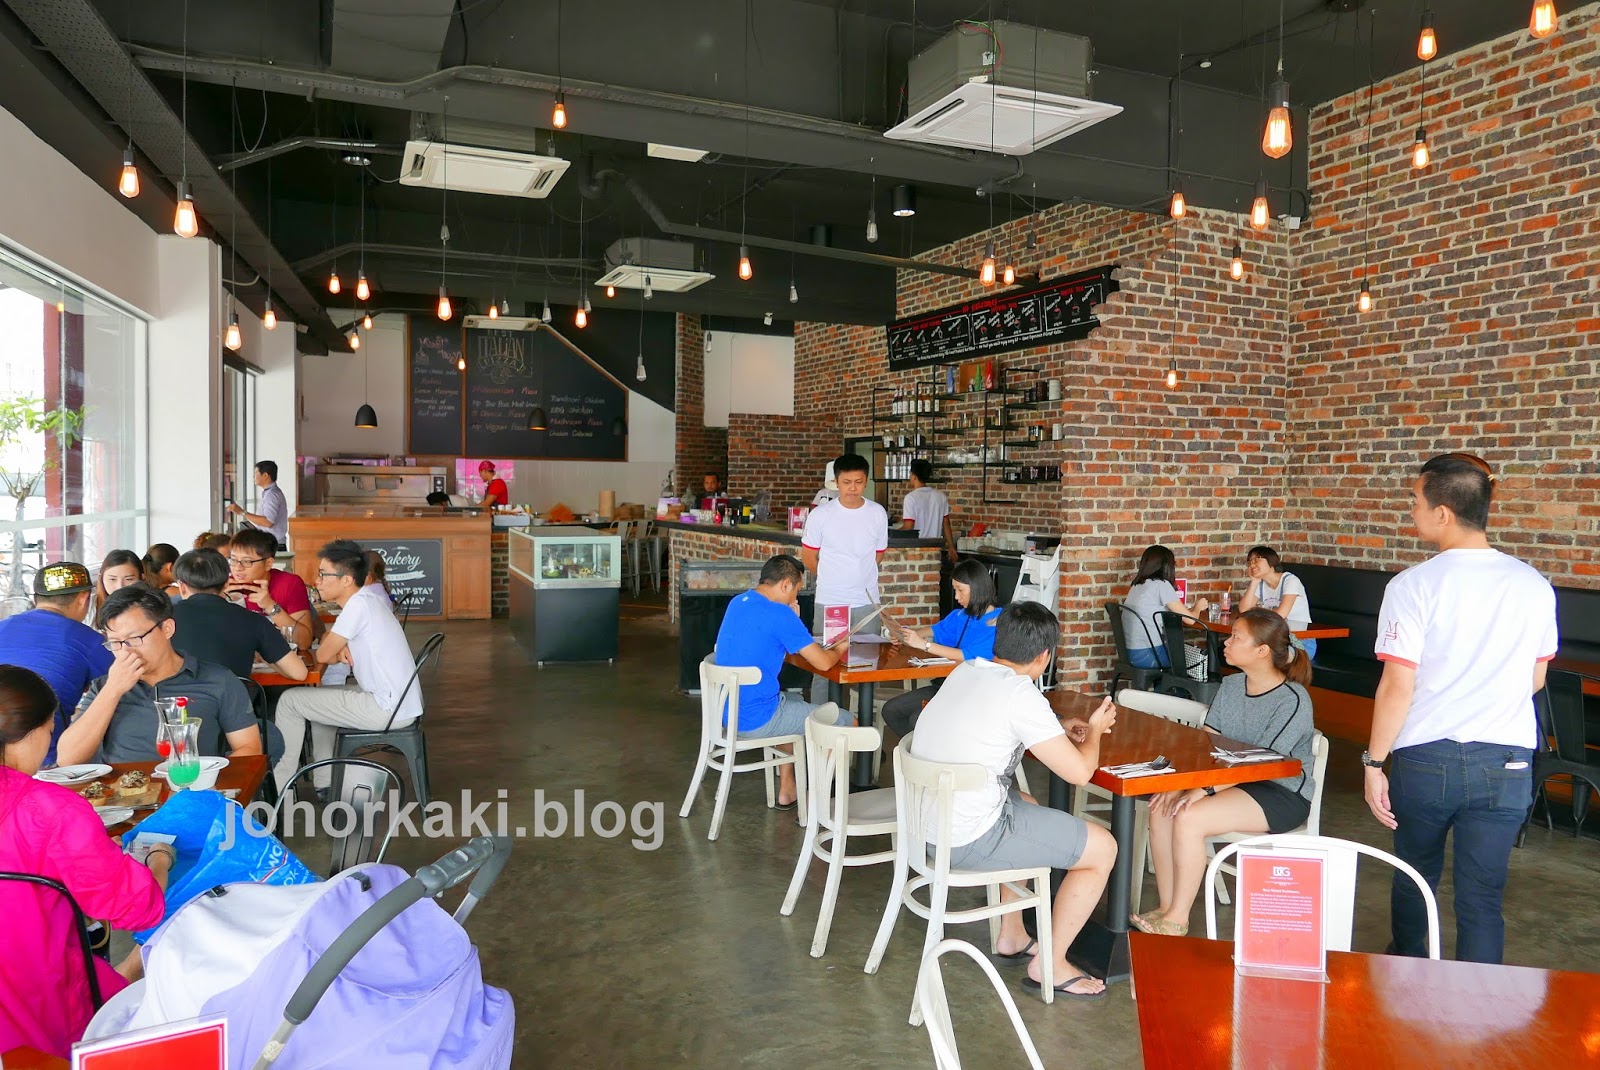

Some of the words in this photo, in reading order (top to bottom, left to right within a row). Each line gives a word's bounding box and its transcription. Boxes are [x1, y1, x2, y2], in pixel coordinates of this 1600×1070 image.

[371, 548, 422, 571] Bakery
[390, 587, 411, 595] AN'T
[412, 587, 434, 595] STAY
